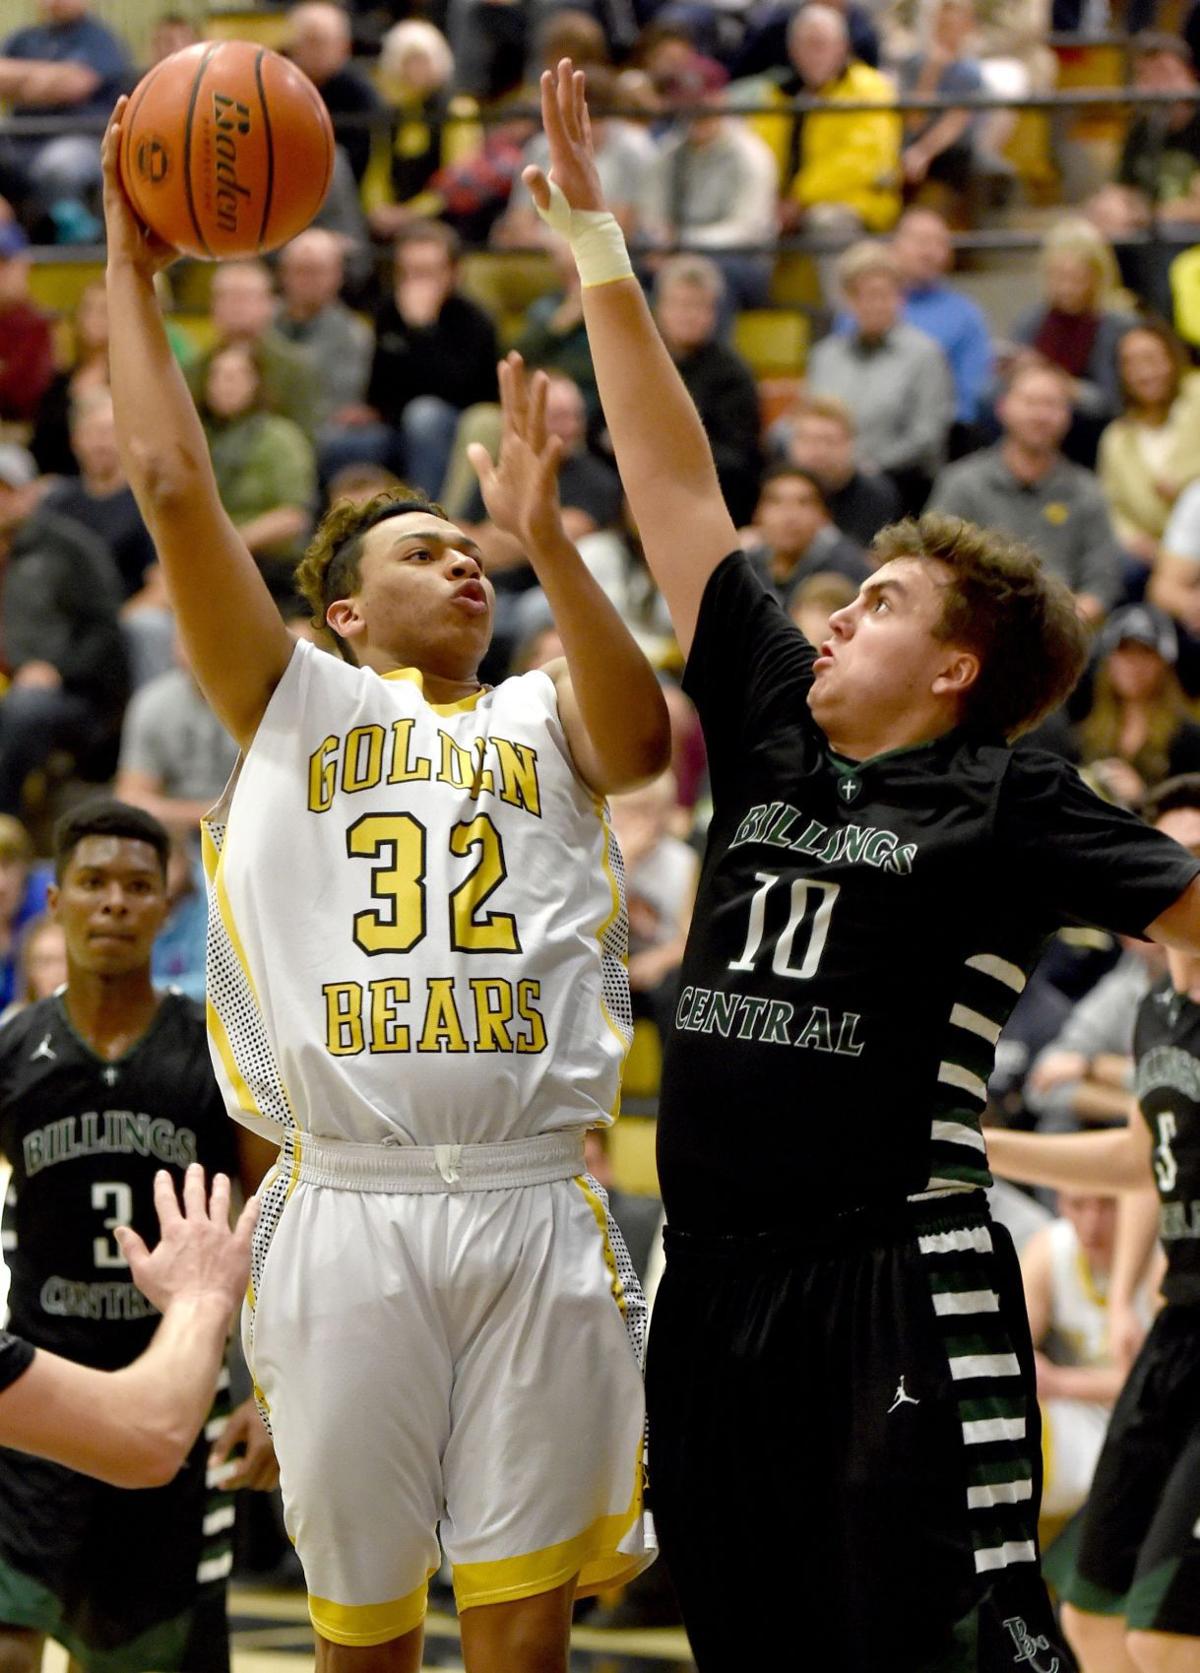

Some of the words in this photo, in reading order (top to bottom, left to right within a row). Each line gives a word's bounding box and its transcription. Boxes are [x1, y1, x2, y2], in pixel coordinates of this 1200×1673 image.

[213, 91, 251, 233] Baden
[307, 718, 542, 818] GOLDEN
[728, 802, 918, 875] BILLINGS
[345, 811, 523, 957] 32
[727, 872, 841, 979] 10
[322, 976, 548, 1057] BEARS
[675, 986, 866, 1057] CENTRAL
[22, 1110, 199, 1178] BILLINGS
[91, 1182, 133, 1268] 3
[40, 1275, 160, 1320] CENTR
